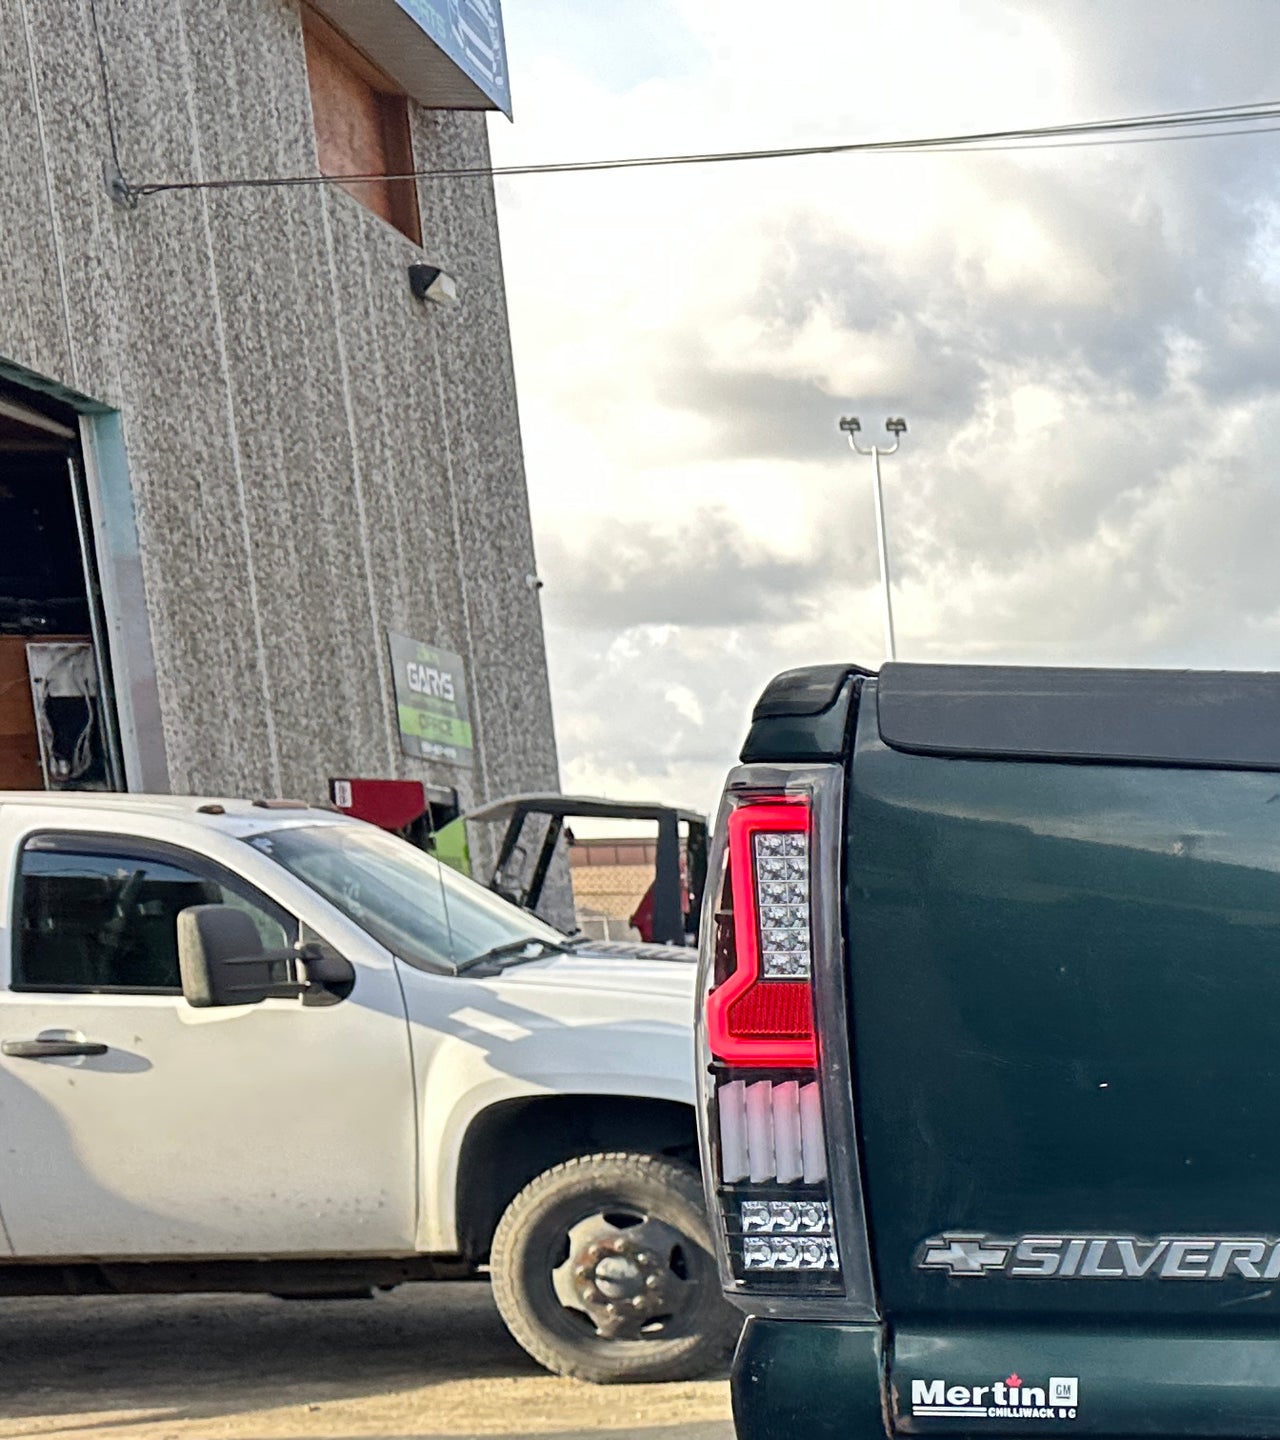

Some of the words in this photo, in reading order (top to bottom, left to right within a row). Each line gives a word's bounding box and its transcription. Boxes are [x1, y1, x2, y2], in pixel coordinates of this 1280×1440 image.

[911, 1378, 1046, 1406] Mertin
[1055, 1384, 1072, 1396] GM
[987, 1407, 1055, 1418] CHILLIWACK
